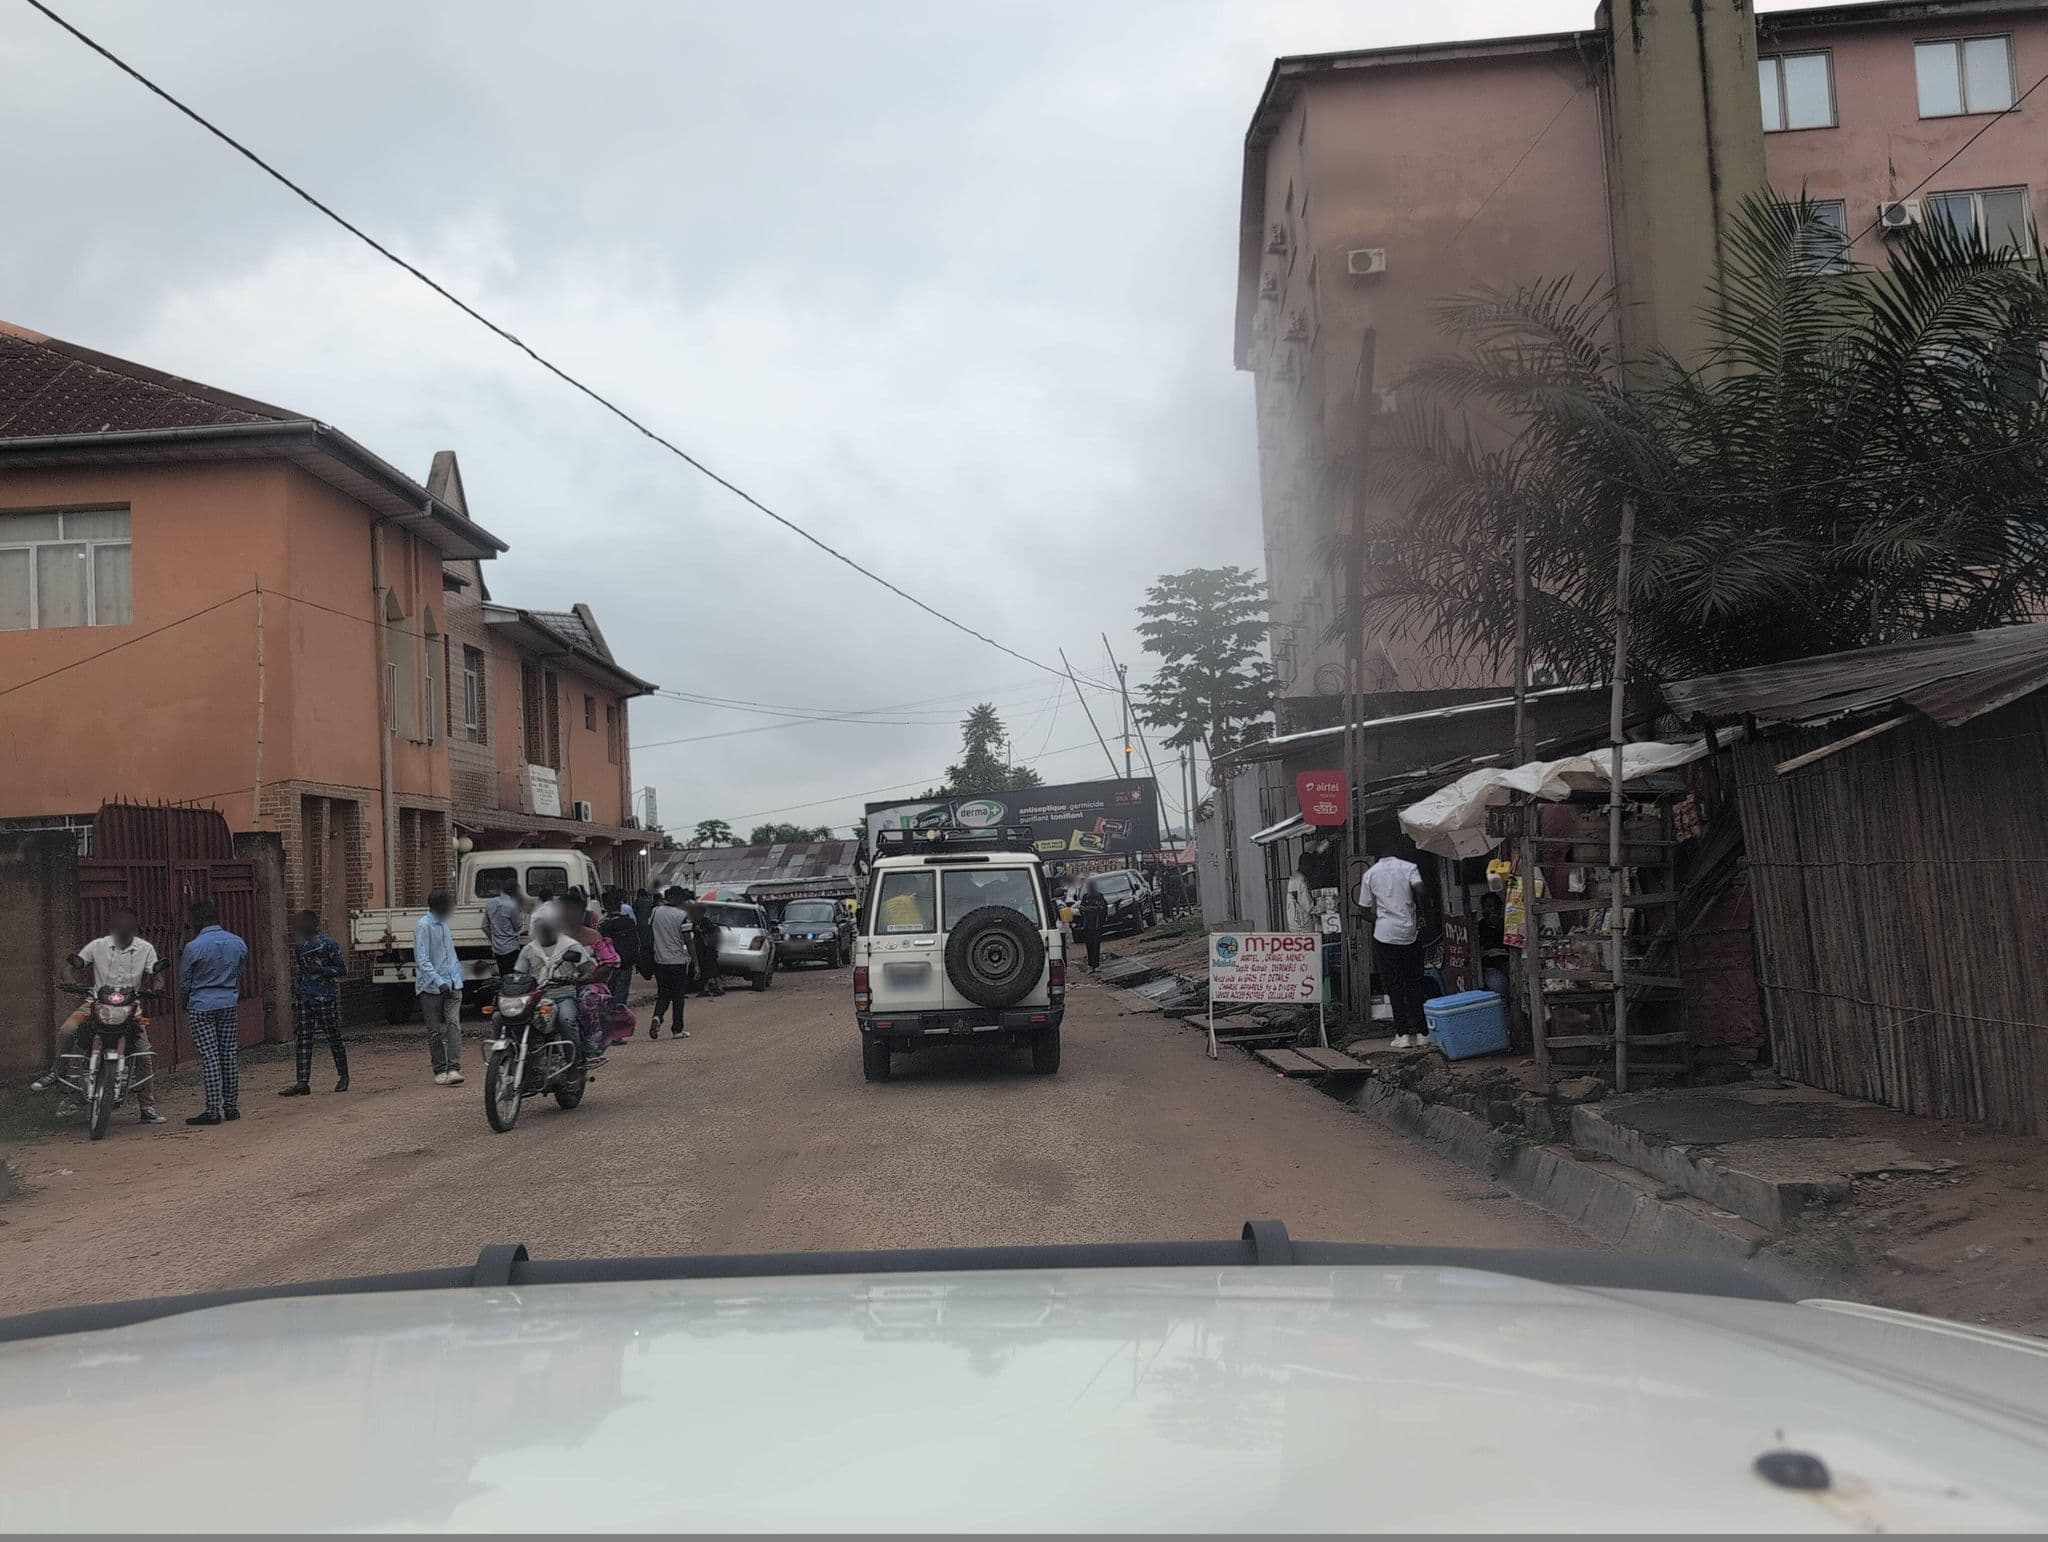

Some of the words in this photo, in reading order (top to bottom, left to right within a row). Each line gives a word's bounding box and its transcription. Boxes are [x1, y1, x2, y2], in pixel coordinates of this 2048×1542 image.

[1316, 783, 1339, 791] airtel
[1019, 804, 1067, 813] antiseptique
[1069, 801, 1105, 810] germicide
[1020, 814, 1048, 824] purifiant
[1050, 812, 1083, 820] tonifiant
[1245, 936, 1315, 953] m-pesa
